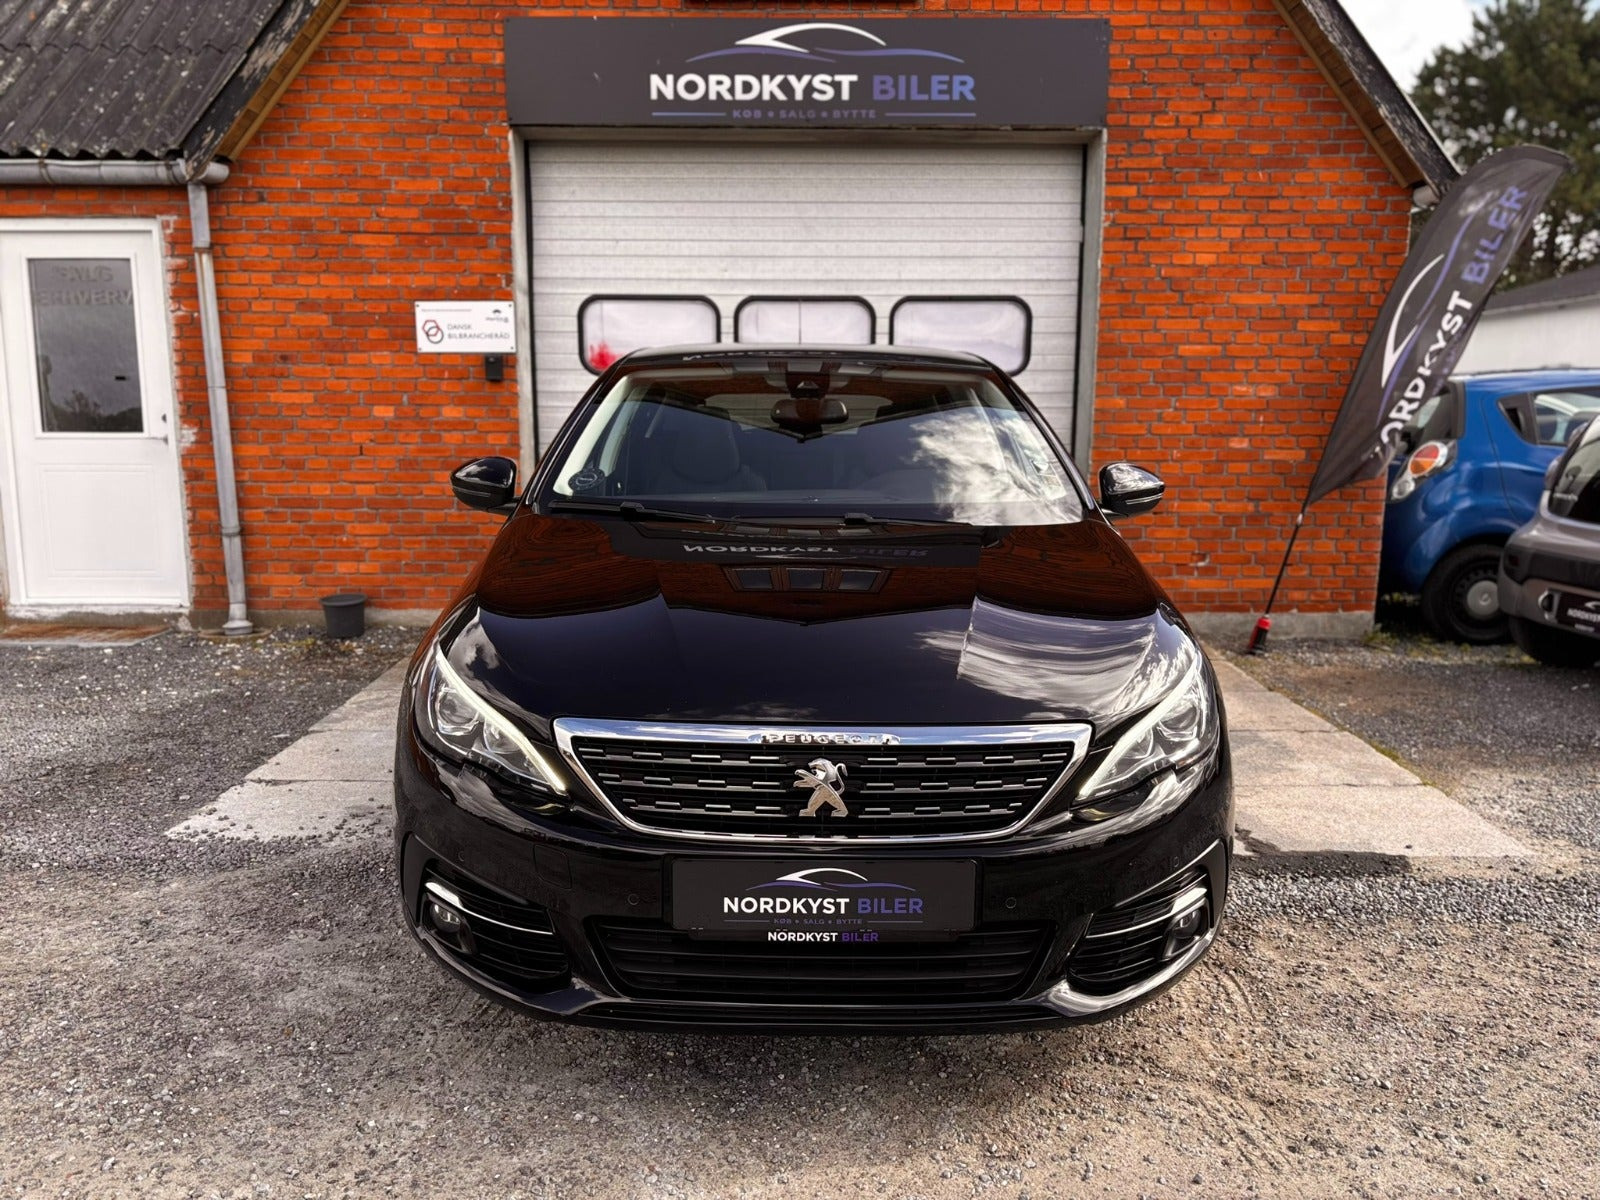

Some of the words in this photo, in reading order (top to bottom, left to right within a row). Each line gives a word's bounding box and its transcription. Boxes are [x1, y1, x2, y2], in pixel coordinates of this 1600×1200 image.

[649, 73, 858, 101] NORDKYST
[873, 74, 976, 101] BILER
[779, 109, 816, 119] SALG
[834, 109, 876, 119] BYTTE
[1460, 185, 1529, 285] BILER
[723, 896, 850, 914] NORDKYST
[857, 897, 924, 914] BILER
[803, 917, 825, 925] SALG
[836, 917, 863, 925] BYTTE
[767, 931, 839, 942] NORDKYST
[841, 931, 879, 942] BILER
